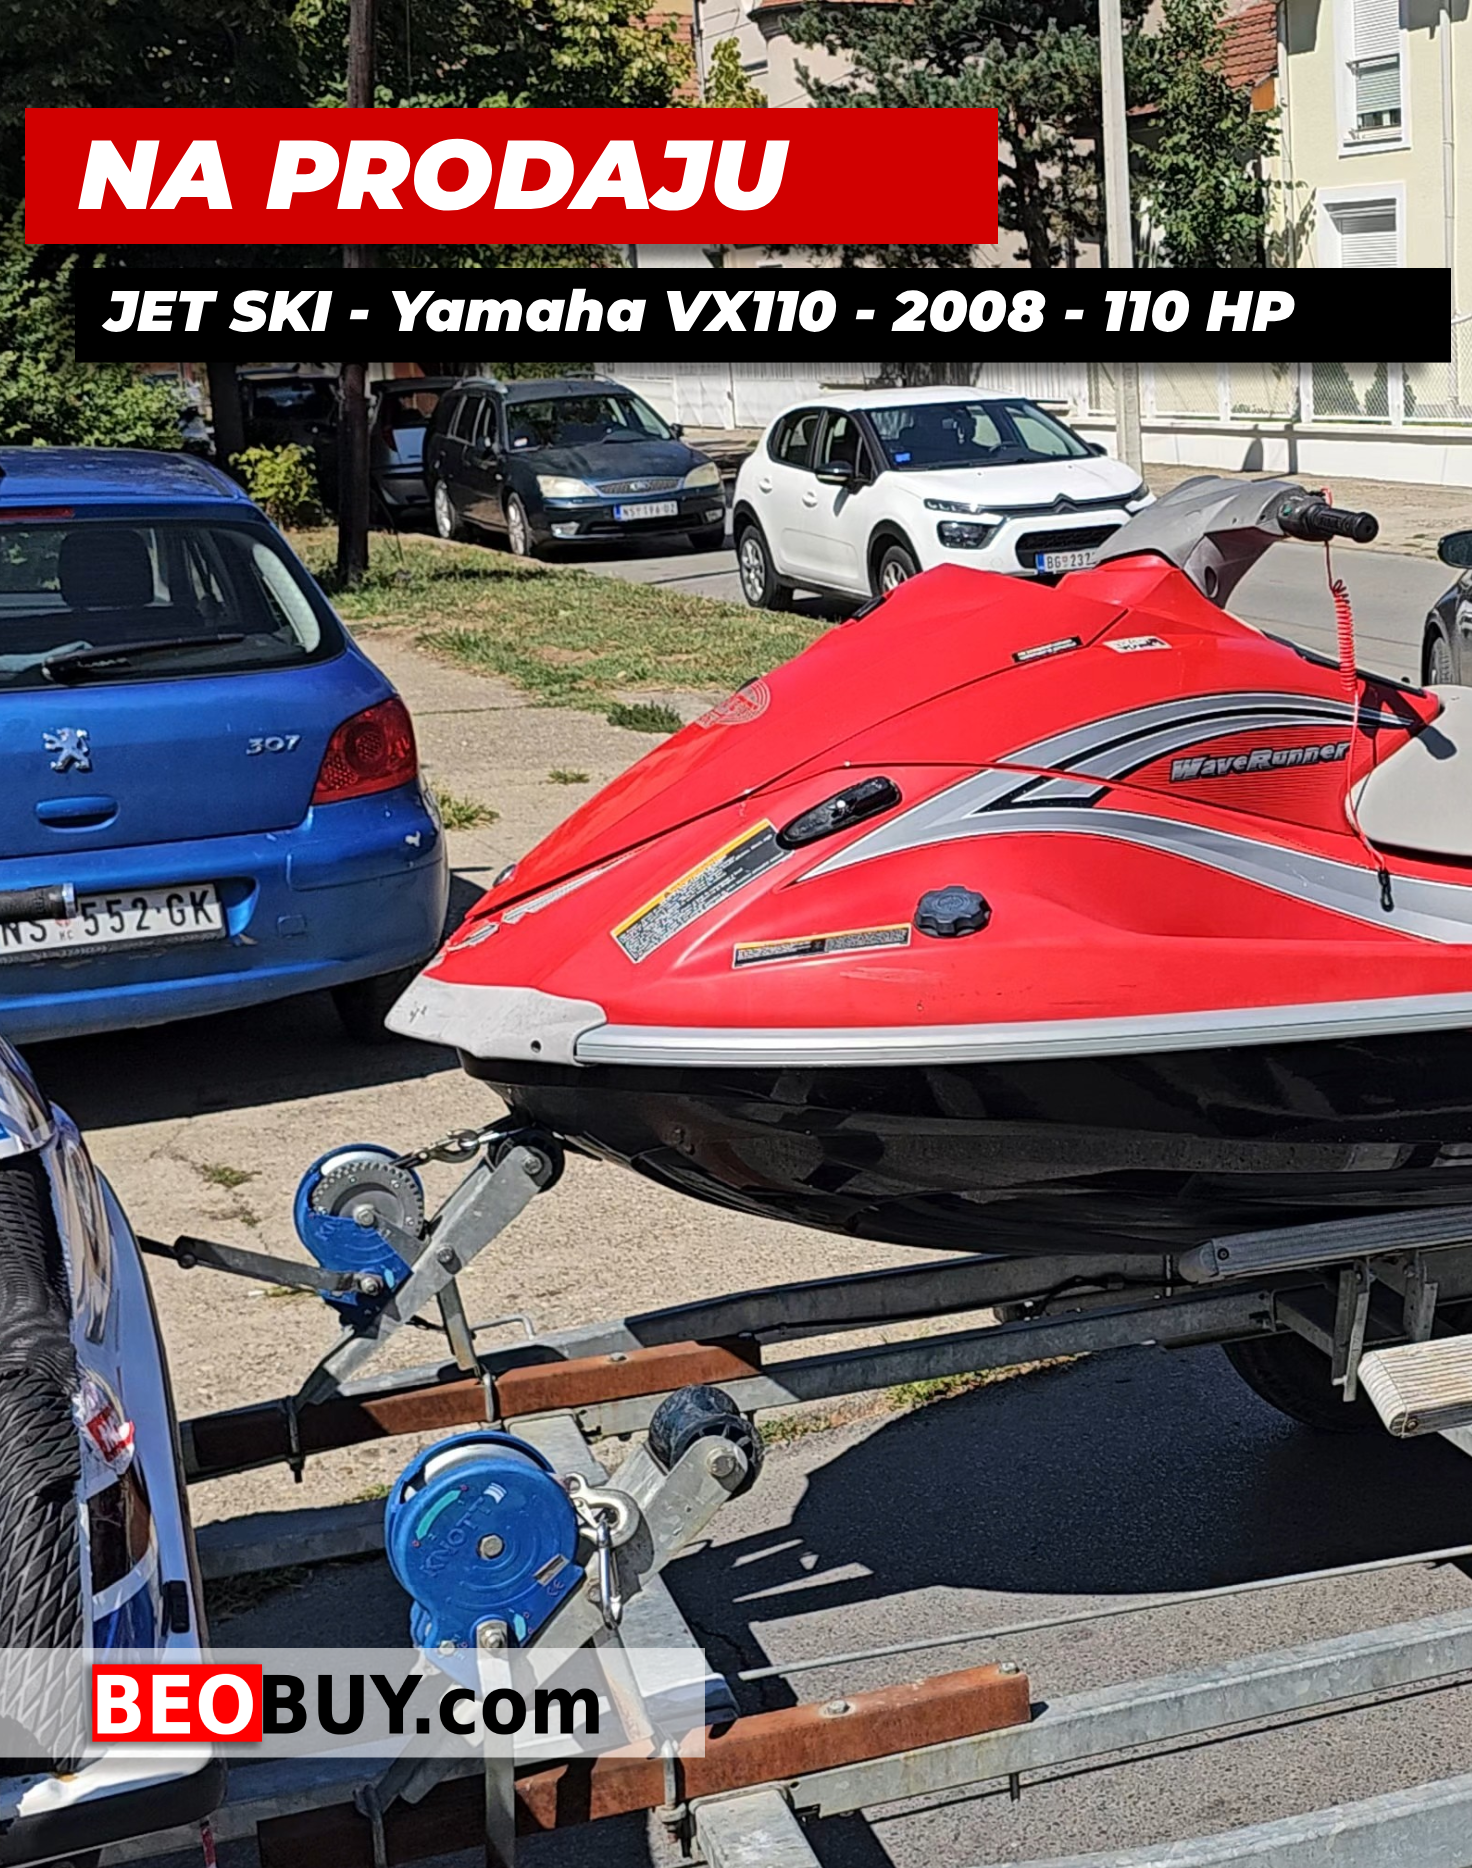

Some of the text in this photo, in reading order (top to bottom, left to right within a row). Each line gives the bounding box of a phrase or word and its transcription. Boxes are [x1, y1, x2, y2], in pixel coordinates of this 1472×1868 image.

[1046, 556, 1062, 570] BG
[246, 734, 301, 756] 307
[1170, 741, 1351, 781] WaveRunner
[420, 1496, 492, 1577] KNOTT
